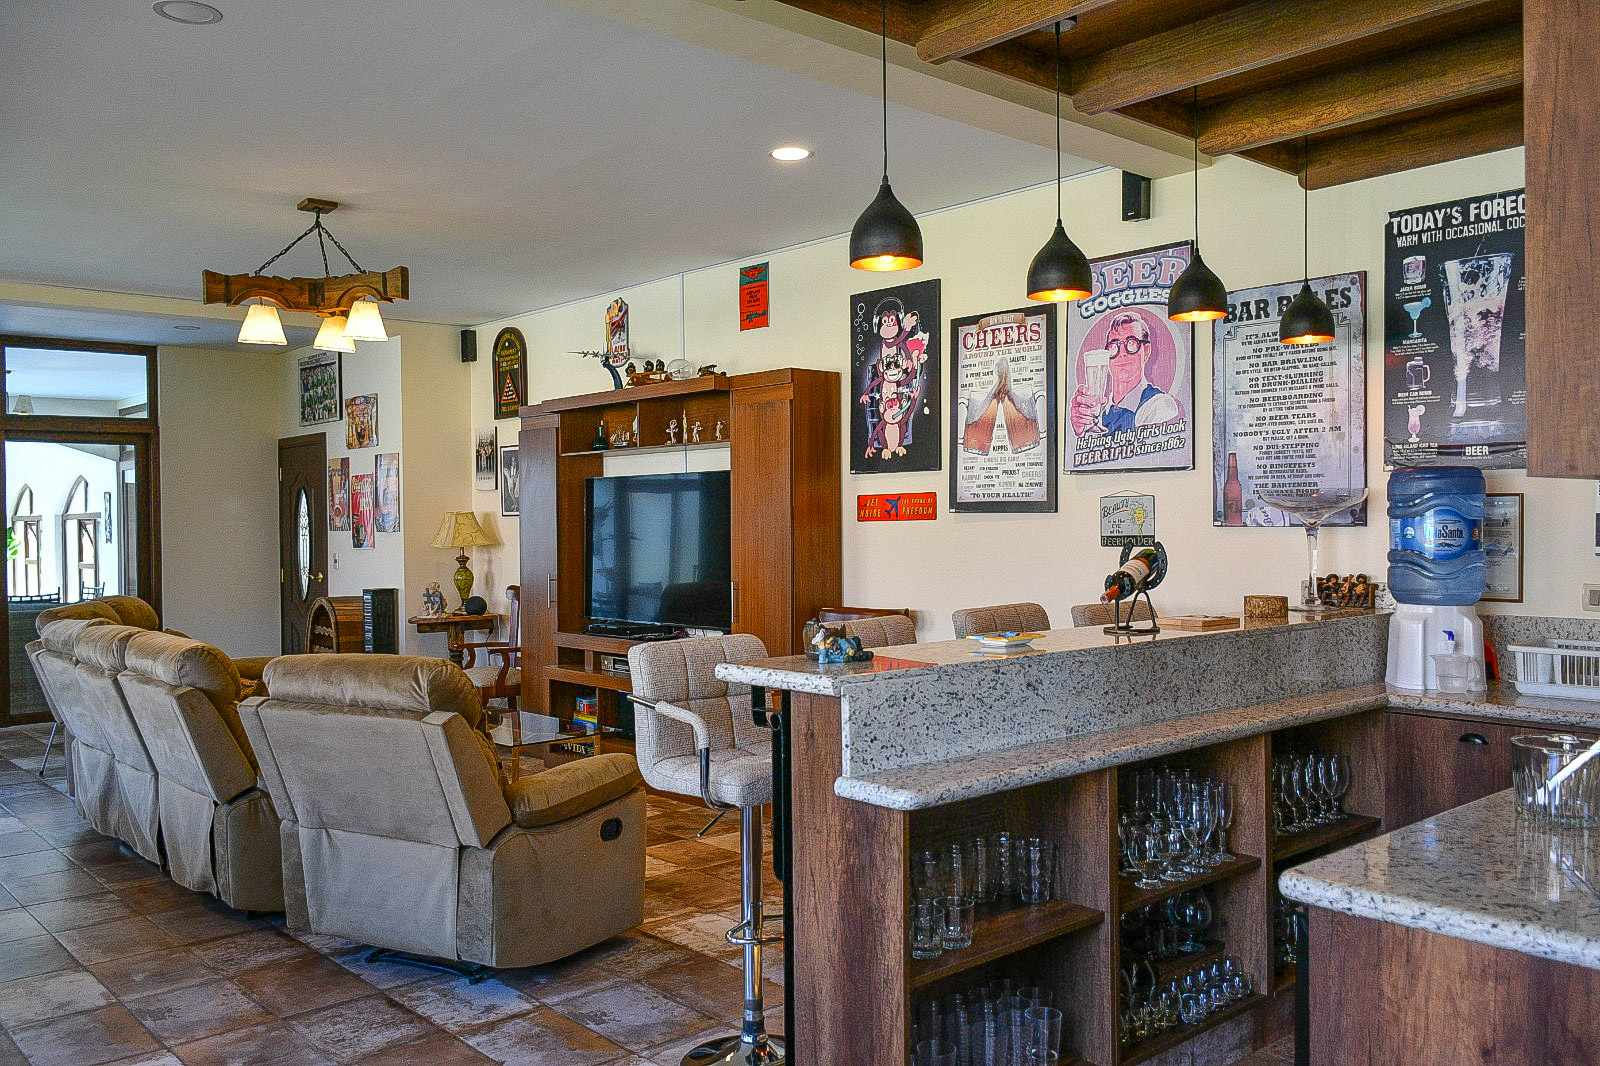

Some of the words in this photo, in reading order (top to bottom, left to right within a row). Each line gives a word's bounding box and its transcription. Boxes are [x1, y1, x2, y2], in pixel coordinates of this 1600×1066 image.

[1391, 206, 1462, 235] TODAY'S
[1396, 234, 1418, 248] WARM
[1421, 230, 1442, 244] WITH
[1445, 220, 1504, 240] OCCASIONAL
[1223, 298, 1270, 324] BAR
[963, 323, 1041, 351] CHEERS
[1245, 332, 1259, 340] IT'S
[1280, 356, 1324, 366] BRAWLING
[1261, 371, 1324, 381] TEXT-SLURRING
[1262, 377, 1324, 388] DRUNK-DIALING
[1262, 392, 1324, 402] BEERBOARDING
[1076, 436, 1112, 450] Helping
[1113, 430, 1136, 445] Ugly
[1137, 424, 1160, 439] Girls
[1161, 418, 1186, 433] Look
[1232, 430, 1270, 438] NOBODY'S
[1271, 428, 1291, 436] UGLY
[1135, 442, 1161, 456] since
[1265, 442, 1320, 450] DUI-STEPPING
[1465, 445, 1489, 456] BEER
[1271, 481, 1319, 489] BARTENDER
[866, 498, 879, 507] JET
[860, 509, 881, 518] NOISE
[902, 506, 933, 515] FREEDOM
